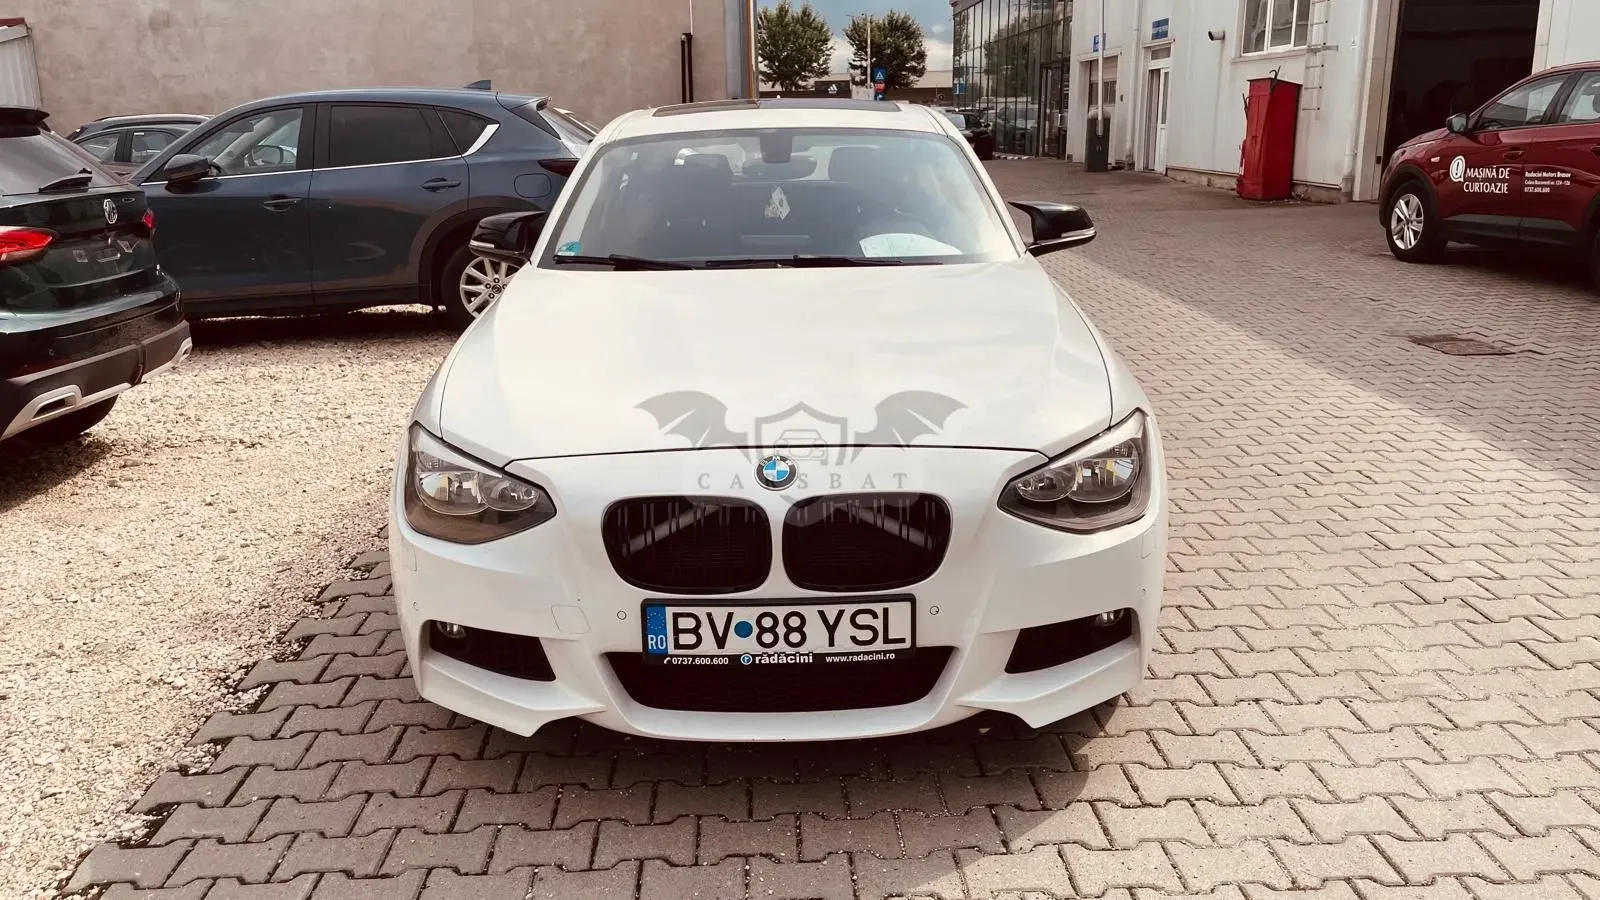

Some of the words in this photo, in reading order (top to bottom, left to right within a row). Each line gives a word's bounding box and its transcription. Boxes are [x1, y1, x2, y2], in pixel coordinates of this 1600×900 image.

[1499, 168, 1511, 179] DE
[1464, 182, 1509, 193] CURTOAZIE
[759, 455, 794, 467] BMW
[673, 612, 734, 650] BV
[755, 611, 807, 649] 88
[817, 607, 906, 647] YSL
[648, 635, 666, 650] RO
[672, 657, 729, 665] 0737.600.600
[825, 652, 895, 663] www.radacini.ro
